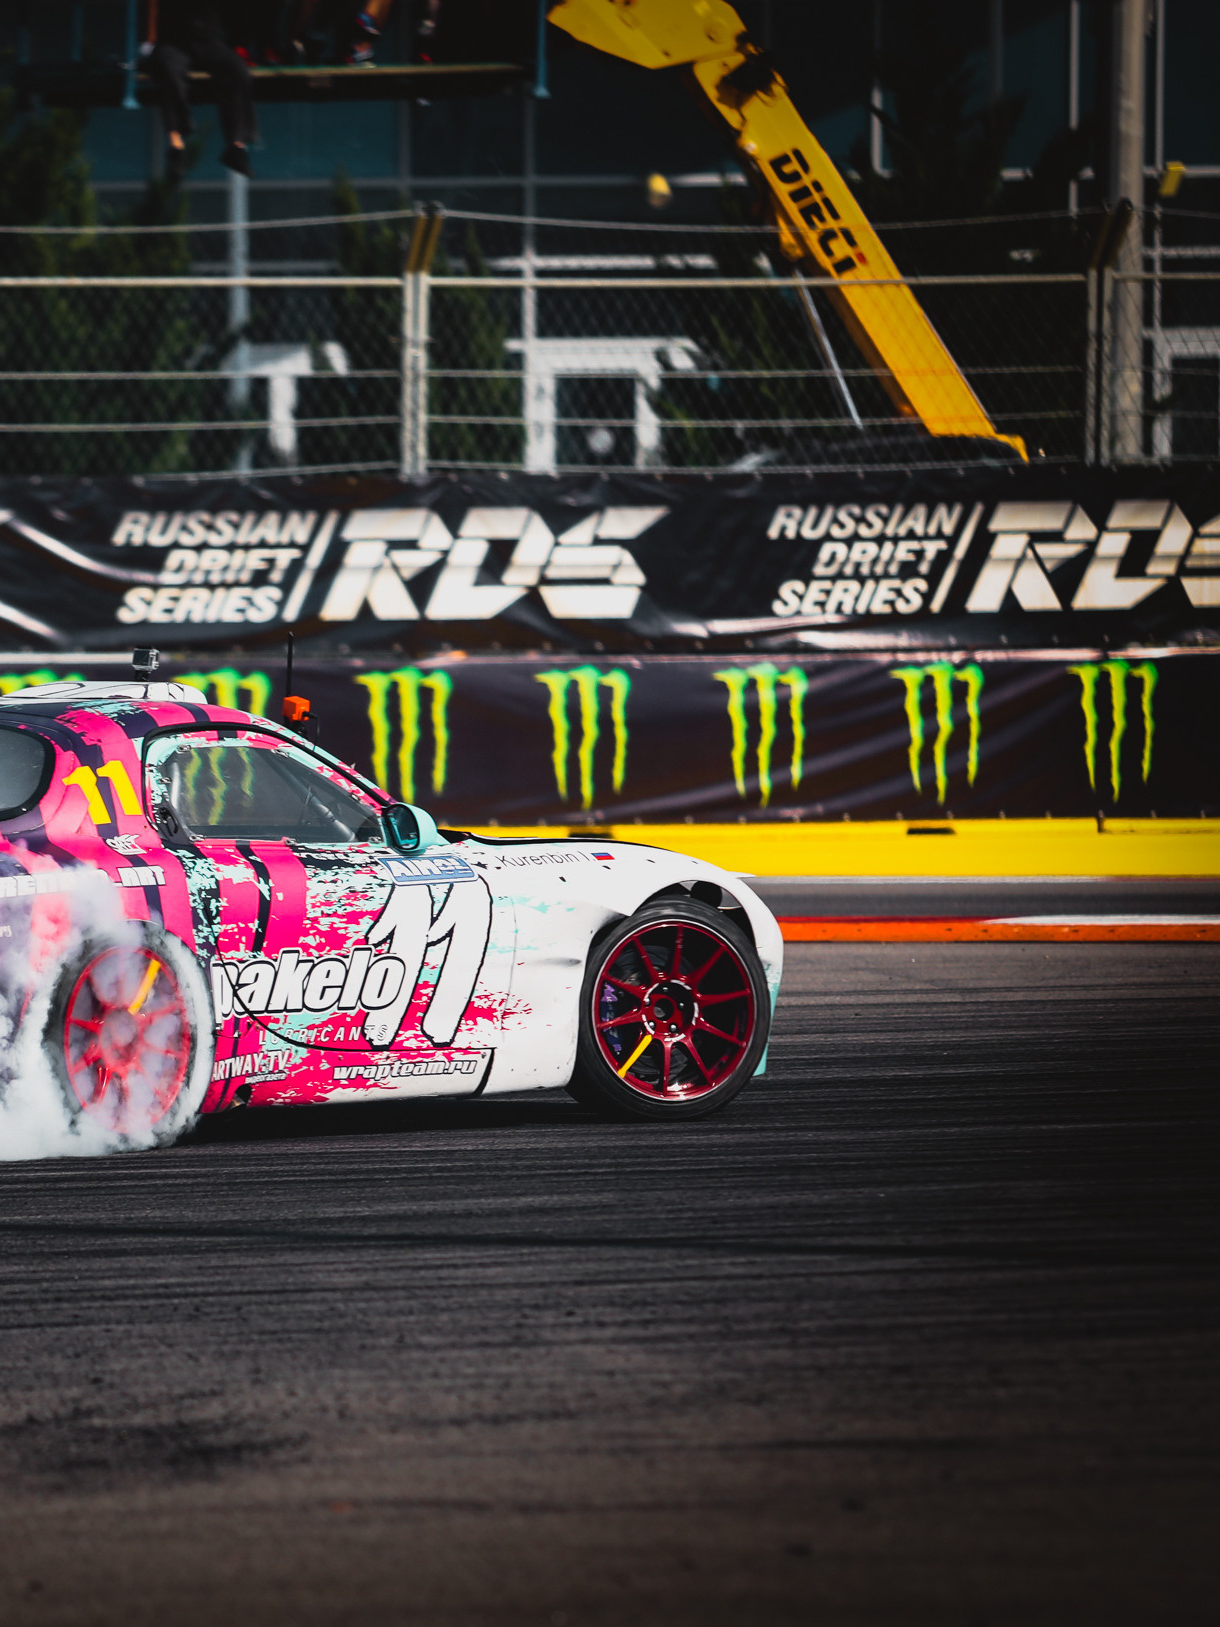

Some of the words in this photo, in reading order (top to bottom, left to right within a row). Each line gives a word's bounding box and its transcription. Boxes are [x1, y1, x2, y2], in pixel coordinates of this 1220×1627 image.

[111, 510, 320, 547] RUSSIAN
[766, 503, 964, 540] RUSSIAN
[159, 548, 303, 584] DRIFT
[320, 506, 670, 622] RDS
[812, 540, 948, 577] DRIFT
[116, 586, 283, 625] SERIES
[772, 578, 930, 617] SERIES
[61, 760, 143, 825] 11
[495, 852, 580, 867] Kurenbin
[364, 873, 493, 1048] 11
[211, 946, 406, 1024] pakelo
[333, 1060, 477, 1081] wrapteam.ru
